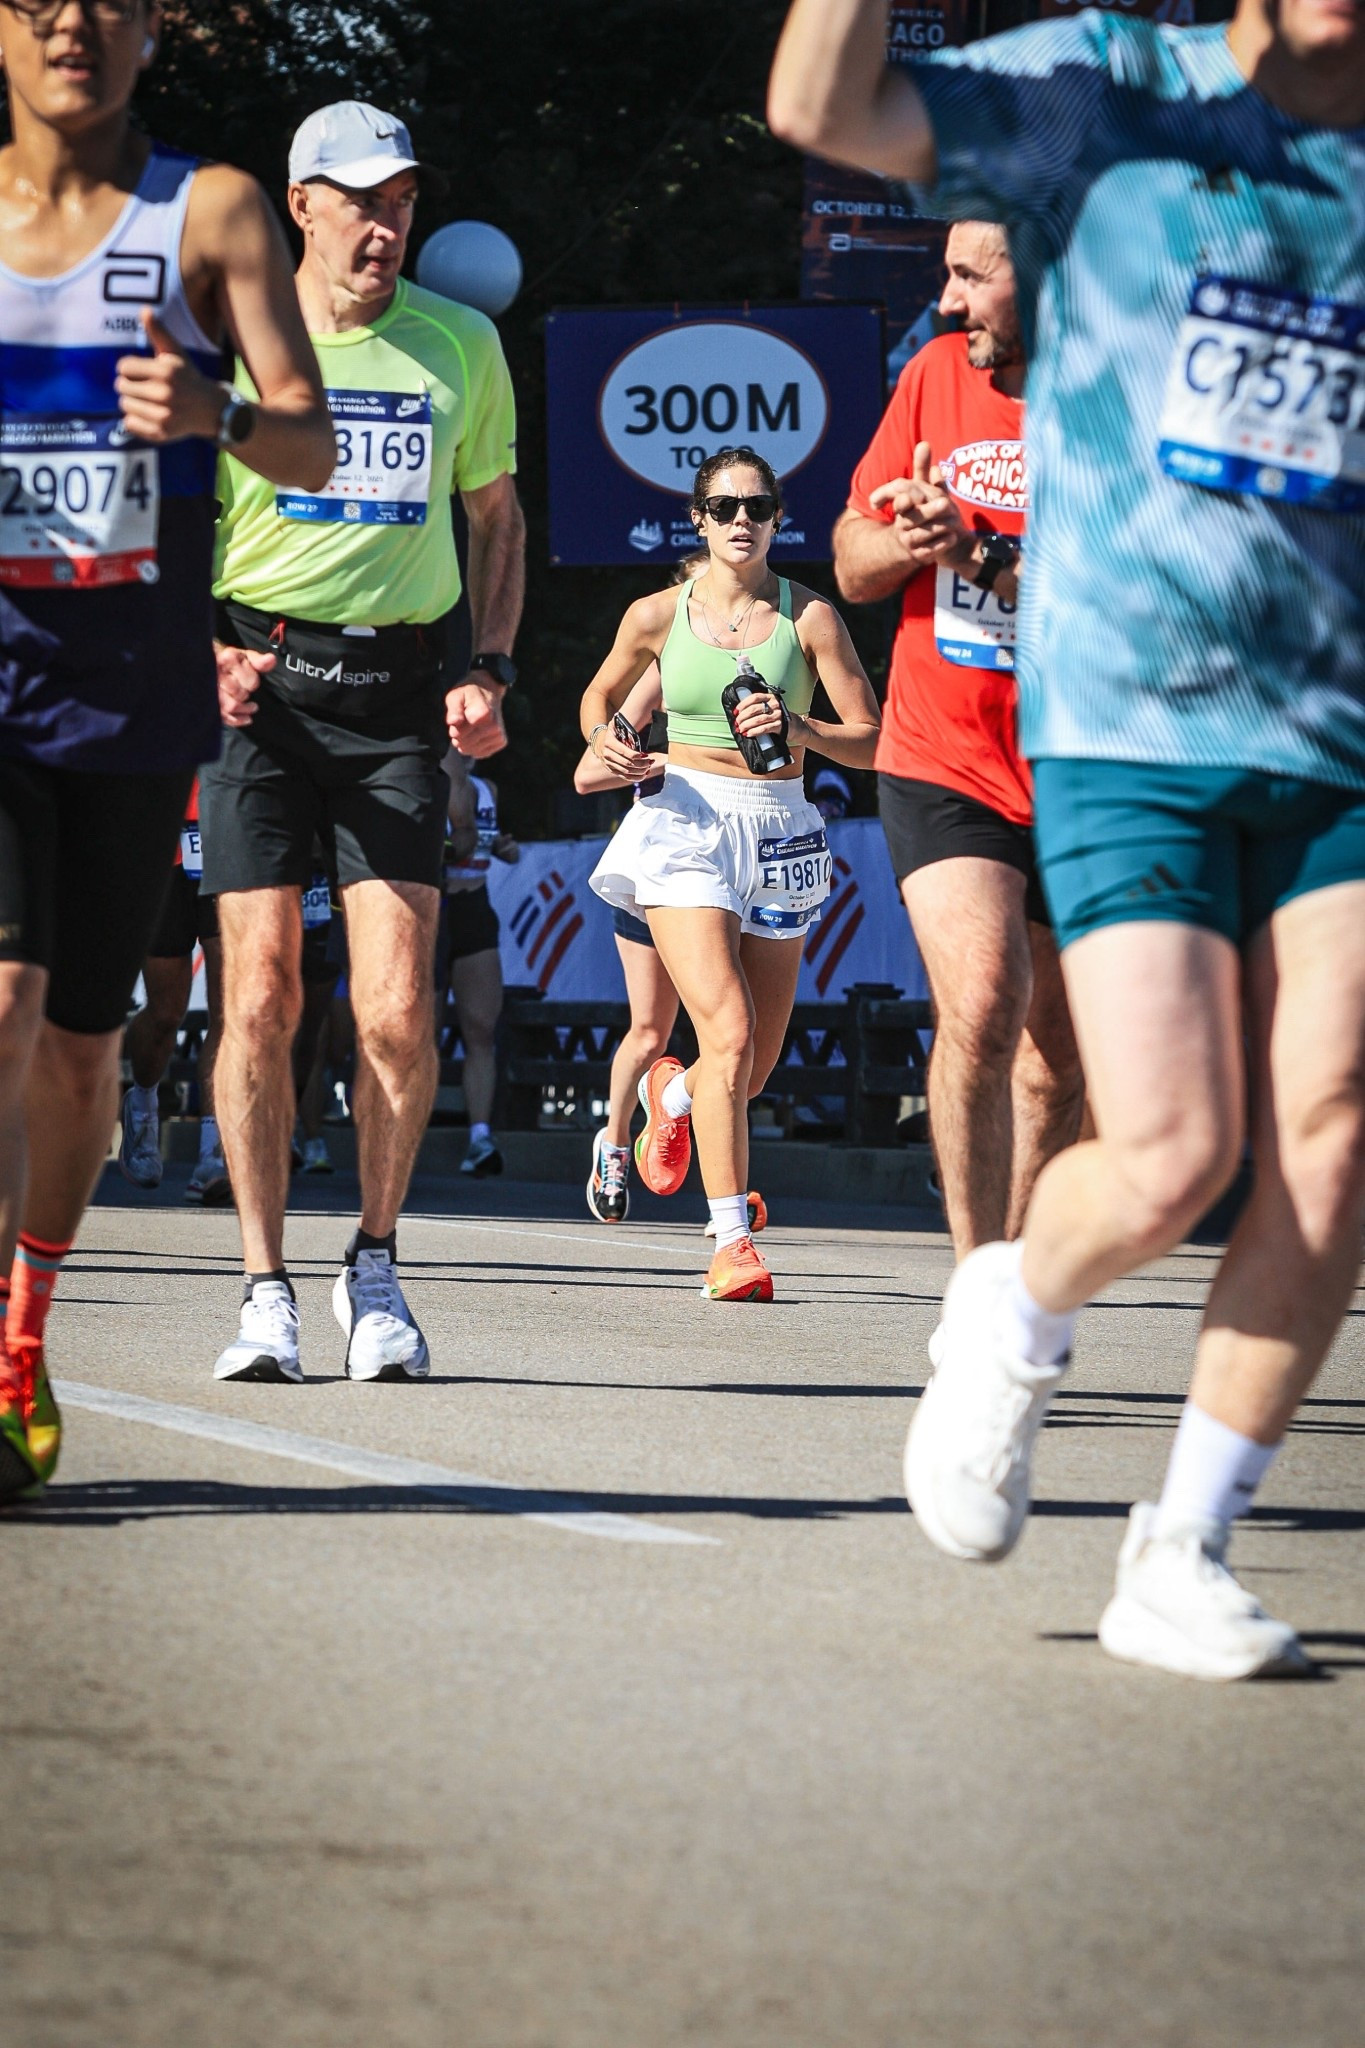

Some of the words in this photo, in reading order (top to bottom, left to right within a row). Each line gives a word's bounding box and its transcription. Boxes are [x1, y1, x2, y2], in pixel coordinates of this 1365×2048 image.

[812, 200, 886, 217] OCTOBER
[1186, 337, 1365, 432] C1573
[343, 404, 386, 416] MARATHON
[671, 446, 707, 469] TO
[955, 444, 998, 466] BANK
[1000, 444, 1021, 459] OF
[957, 472, 1030, 508] MARAT
[671, 533, 704, 548] CHIC
[762, 855, 831, 891] E19810
